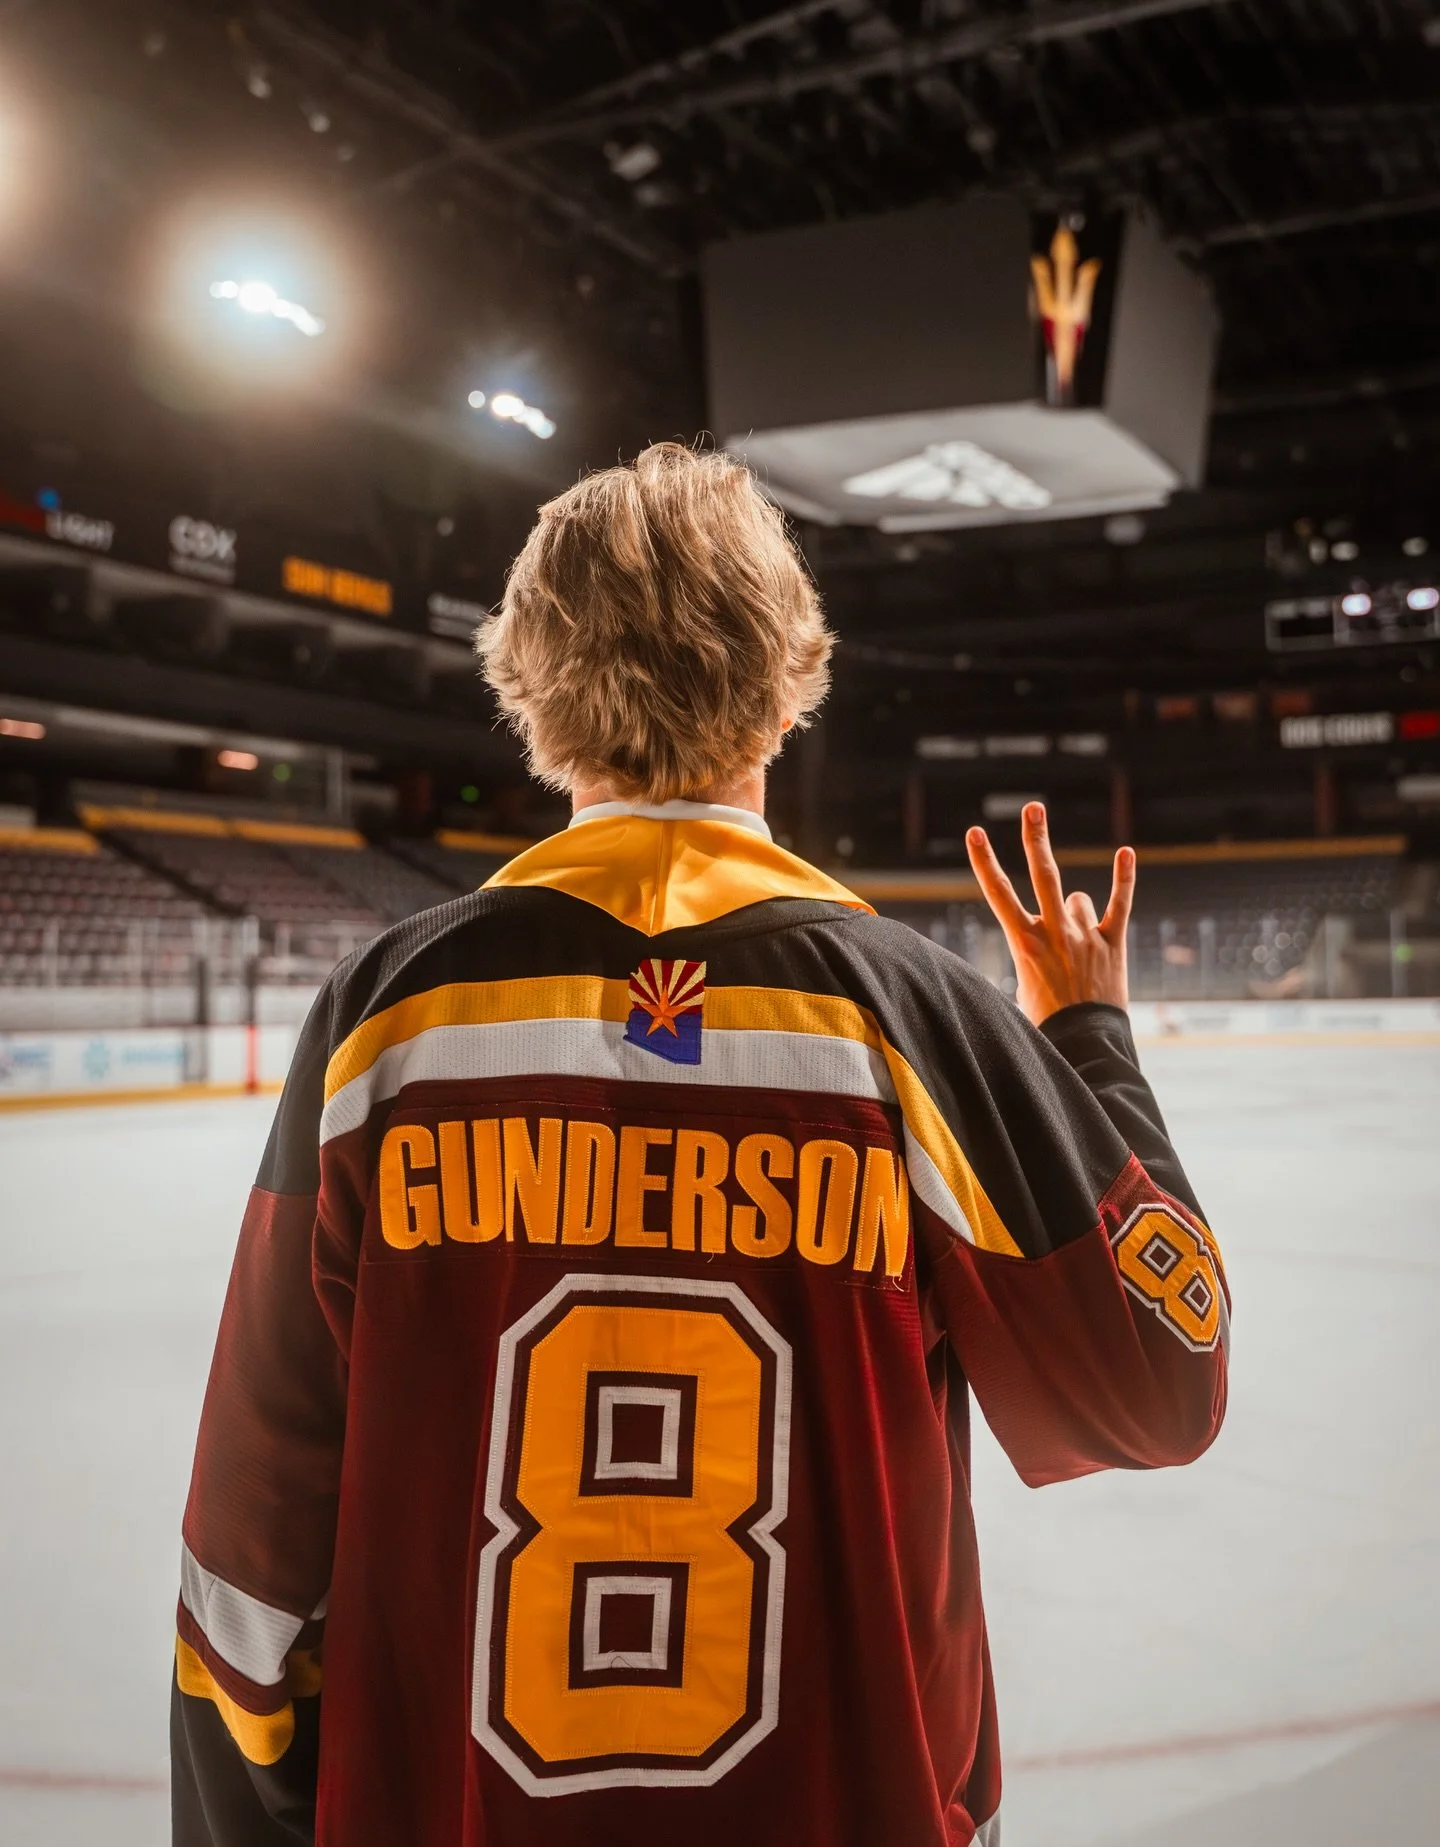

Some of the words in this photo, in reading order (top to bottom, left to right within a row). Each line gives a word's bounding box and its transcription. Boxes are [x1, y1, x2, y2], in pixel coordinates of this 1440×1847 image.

[379, 1117, 909, 1277] GUNDERSON
[1110, 1203, 1223, 1353] 8
[471, 1273, 793, 1798] 8
